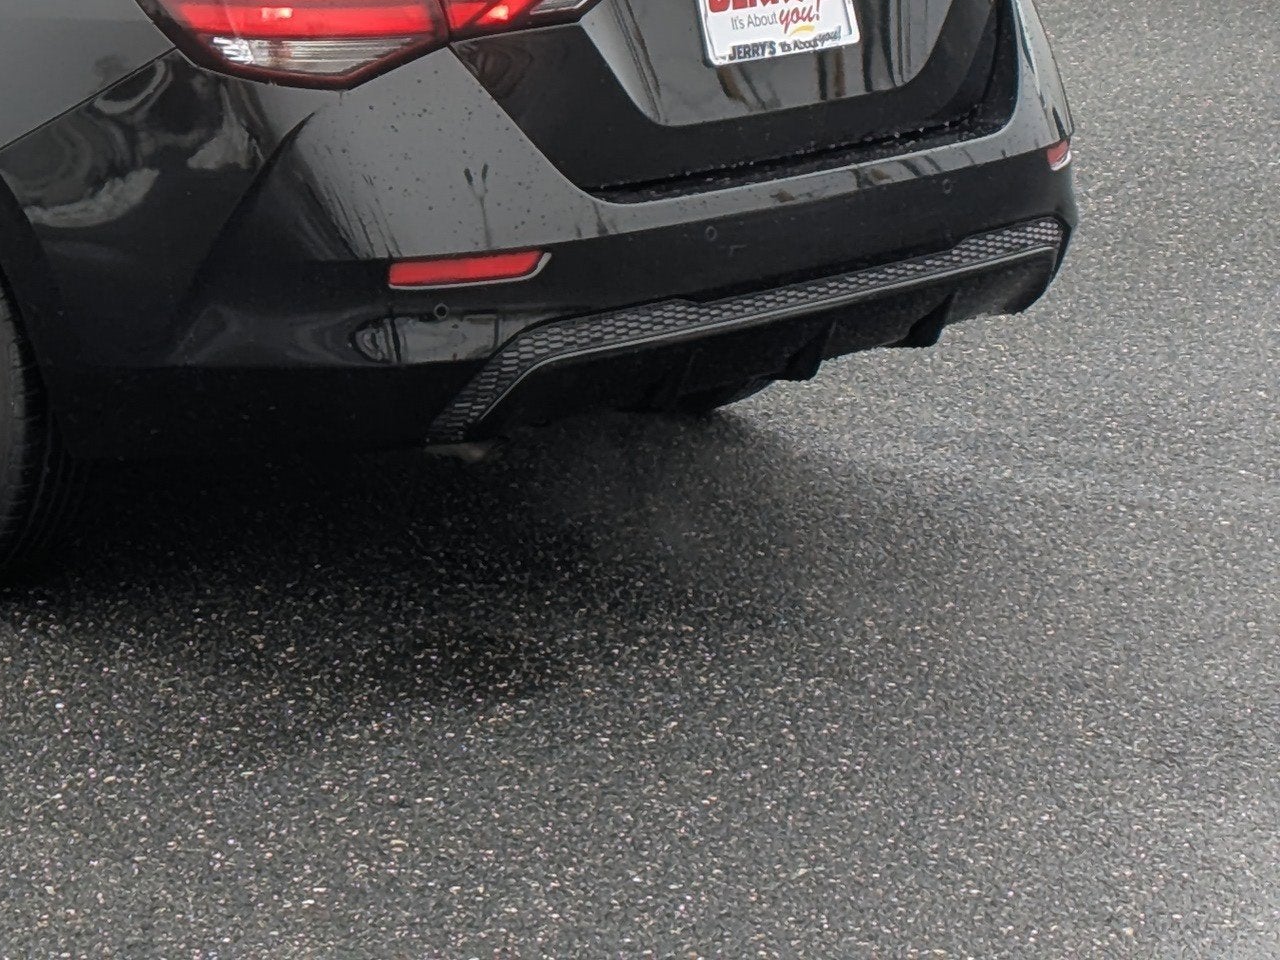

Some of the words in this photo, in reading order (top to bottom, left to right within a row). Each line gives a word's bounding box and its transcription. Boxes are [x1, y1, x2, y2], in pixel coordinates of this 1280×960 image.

[731, 15, 746, 30] It's
[747, 11, 777, 28] About
[728, 40, 776, 60] JERRY'S
[793, 37, 819, 51] About
